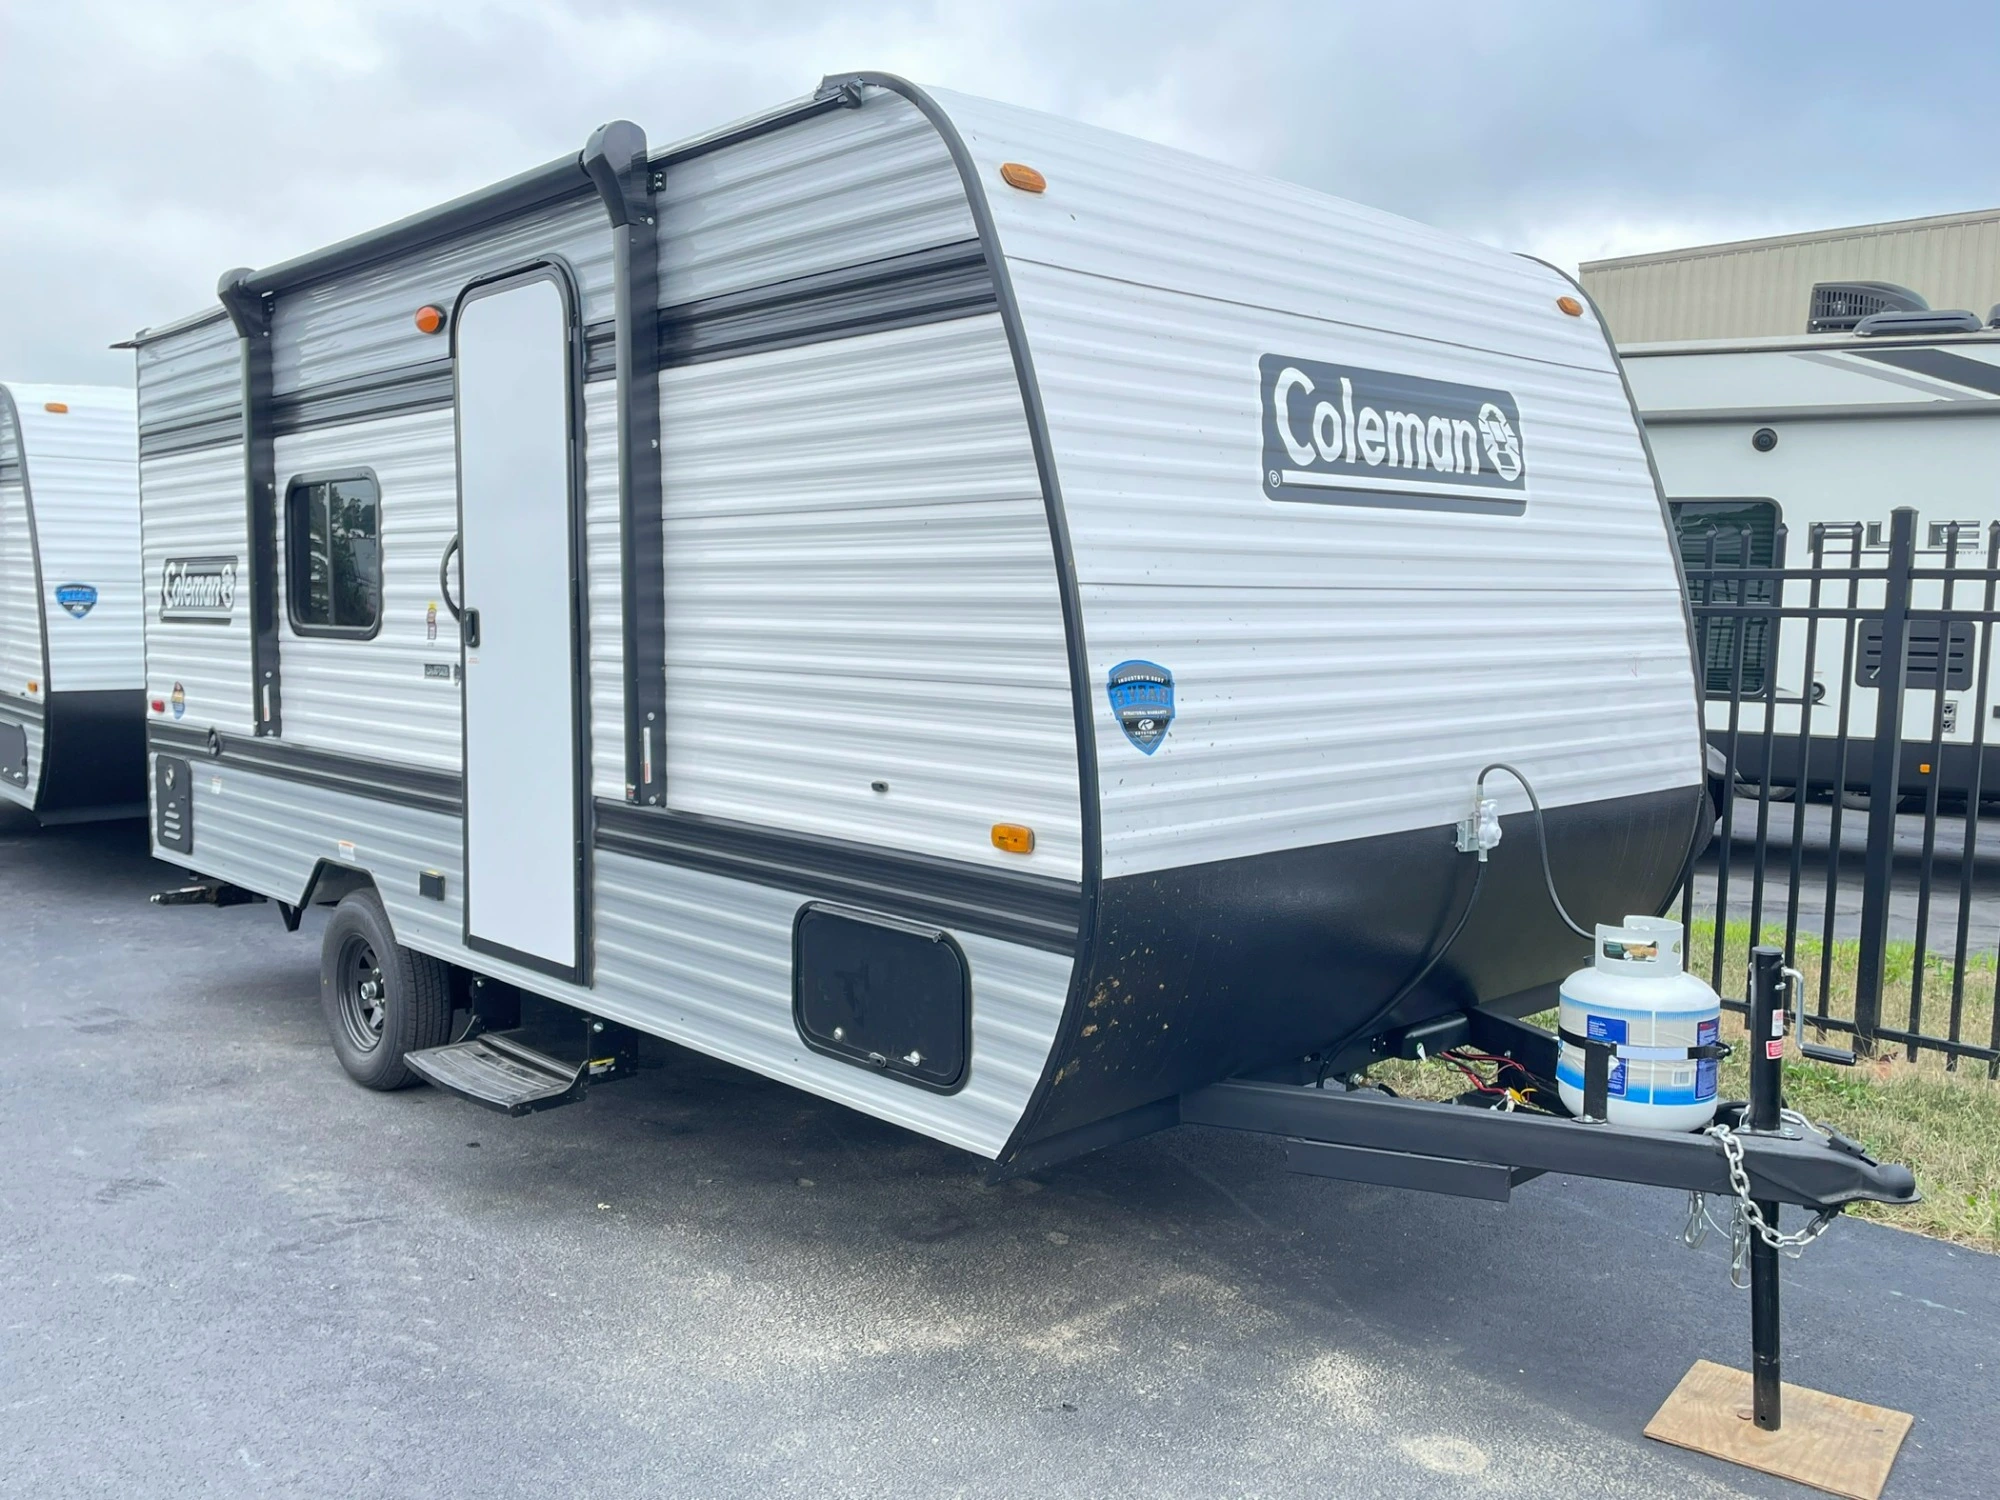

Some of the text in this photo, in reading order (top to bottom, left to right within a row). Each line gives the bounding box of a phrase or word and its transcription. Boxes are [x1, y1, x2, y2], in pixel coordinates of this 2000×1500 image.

[1274, 367, 1479, 475] Coleman
[164, 562, 221, 609] Coleman
[1127, 685, 1168, 704] YEAR
